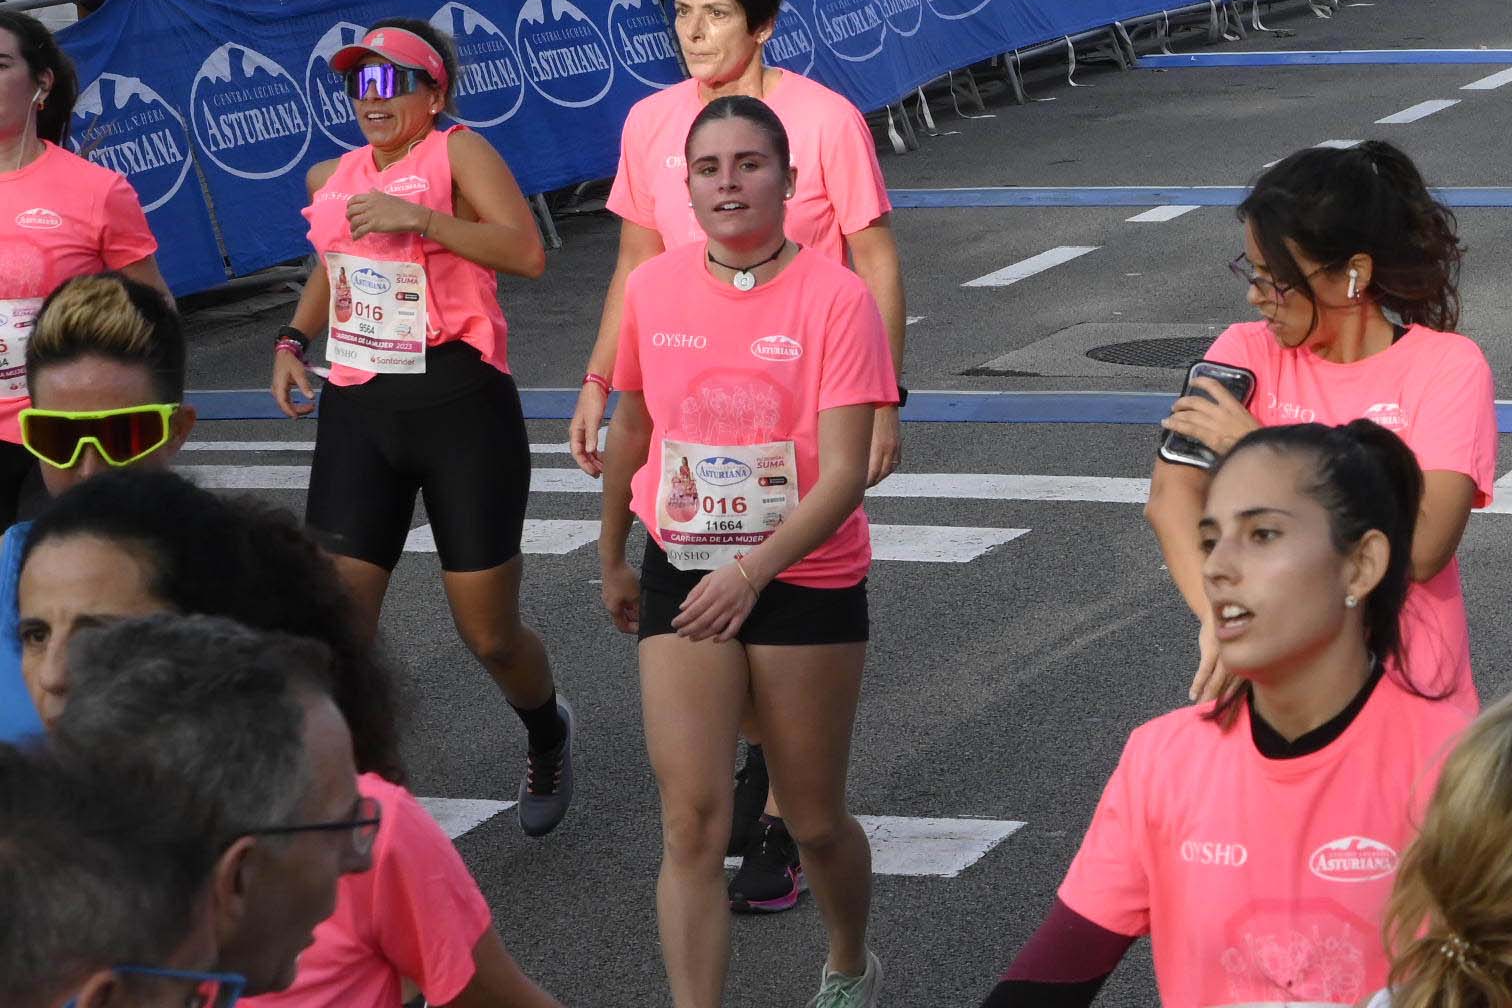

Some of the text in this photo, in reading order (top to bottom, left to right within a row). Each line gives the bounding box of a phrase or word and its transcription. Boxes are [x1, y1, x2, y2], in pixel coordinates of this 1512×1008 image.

[524, 38, 609, 83] ASTURIANA
[455, 57, 520, 98] TURIANA
[202, 99, 307, 153] ASTURIANA
[355, 301, 383, 321] 016
[652, 333, 707, 349] OYSHO
[753, 343, 799, 357] ASTURIANA
[700, 467, 749, 479] ASTURIANA
[756, 460, 785, 469] SUMA
[702, 496, 747, 515] 016
[706, 520, 743, 532] 11664
[671, 533, 764, 543] CARRERA DE LA MUJER
[668, 549, 710, 561] OYSHO
[1180, 840, 1248, 867] OYSHO
[1317, 854, 1392, 872] ASTURIANA
